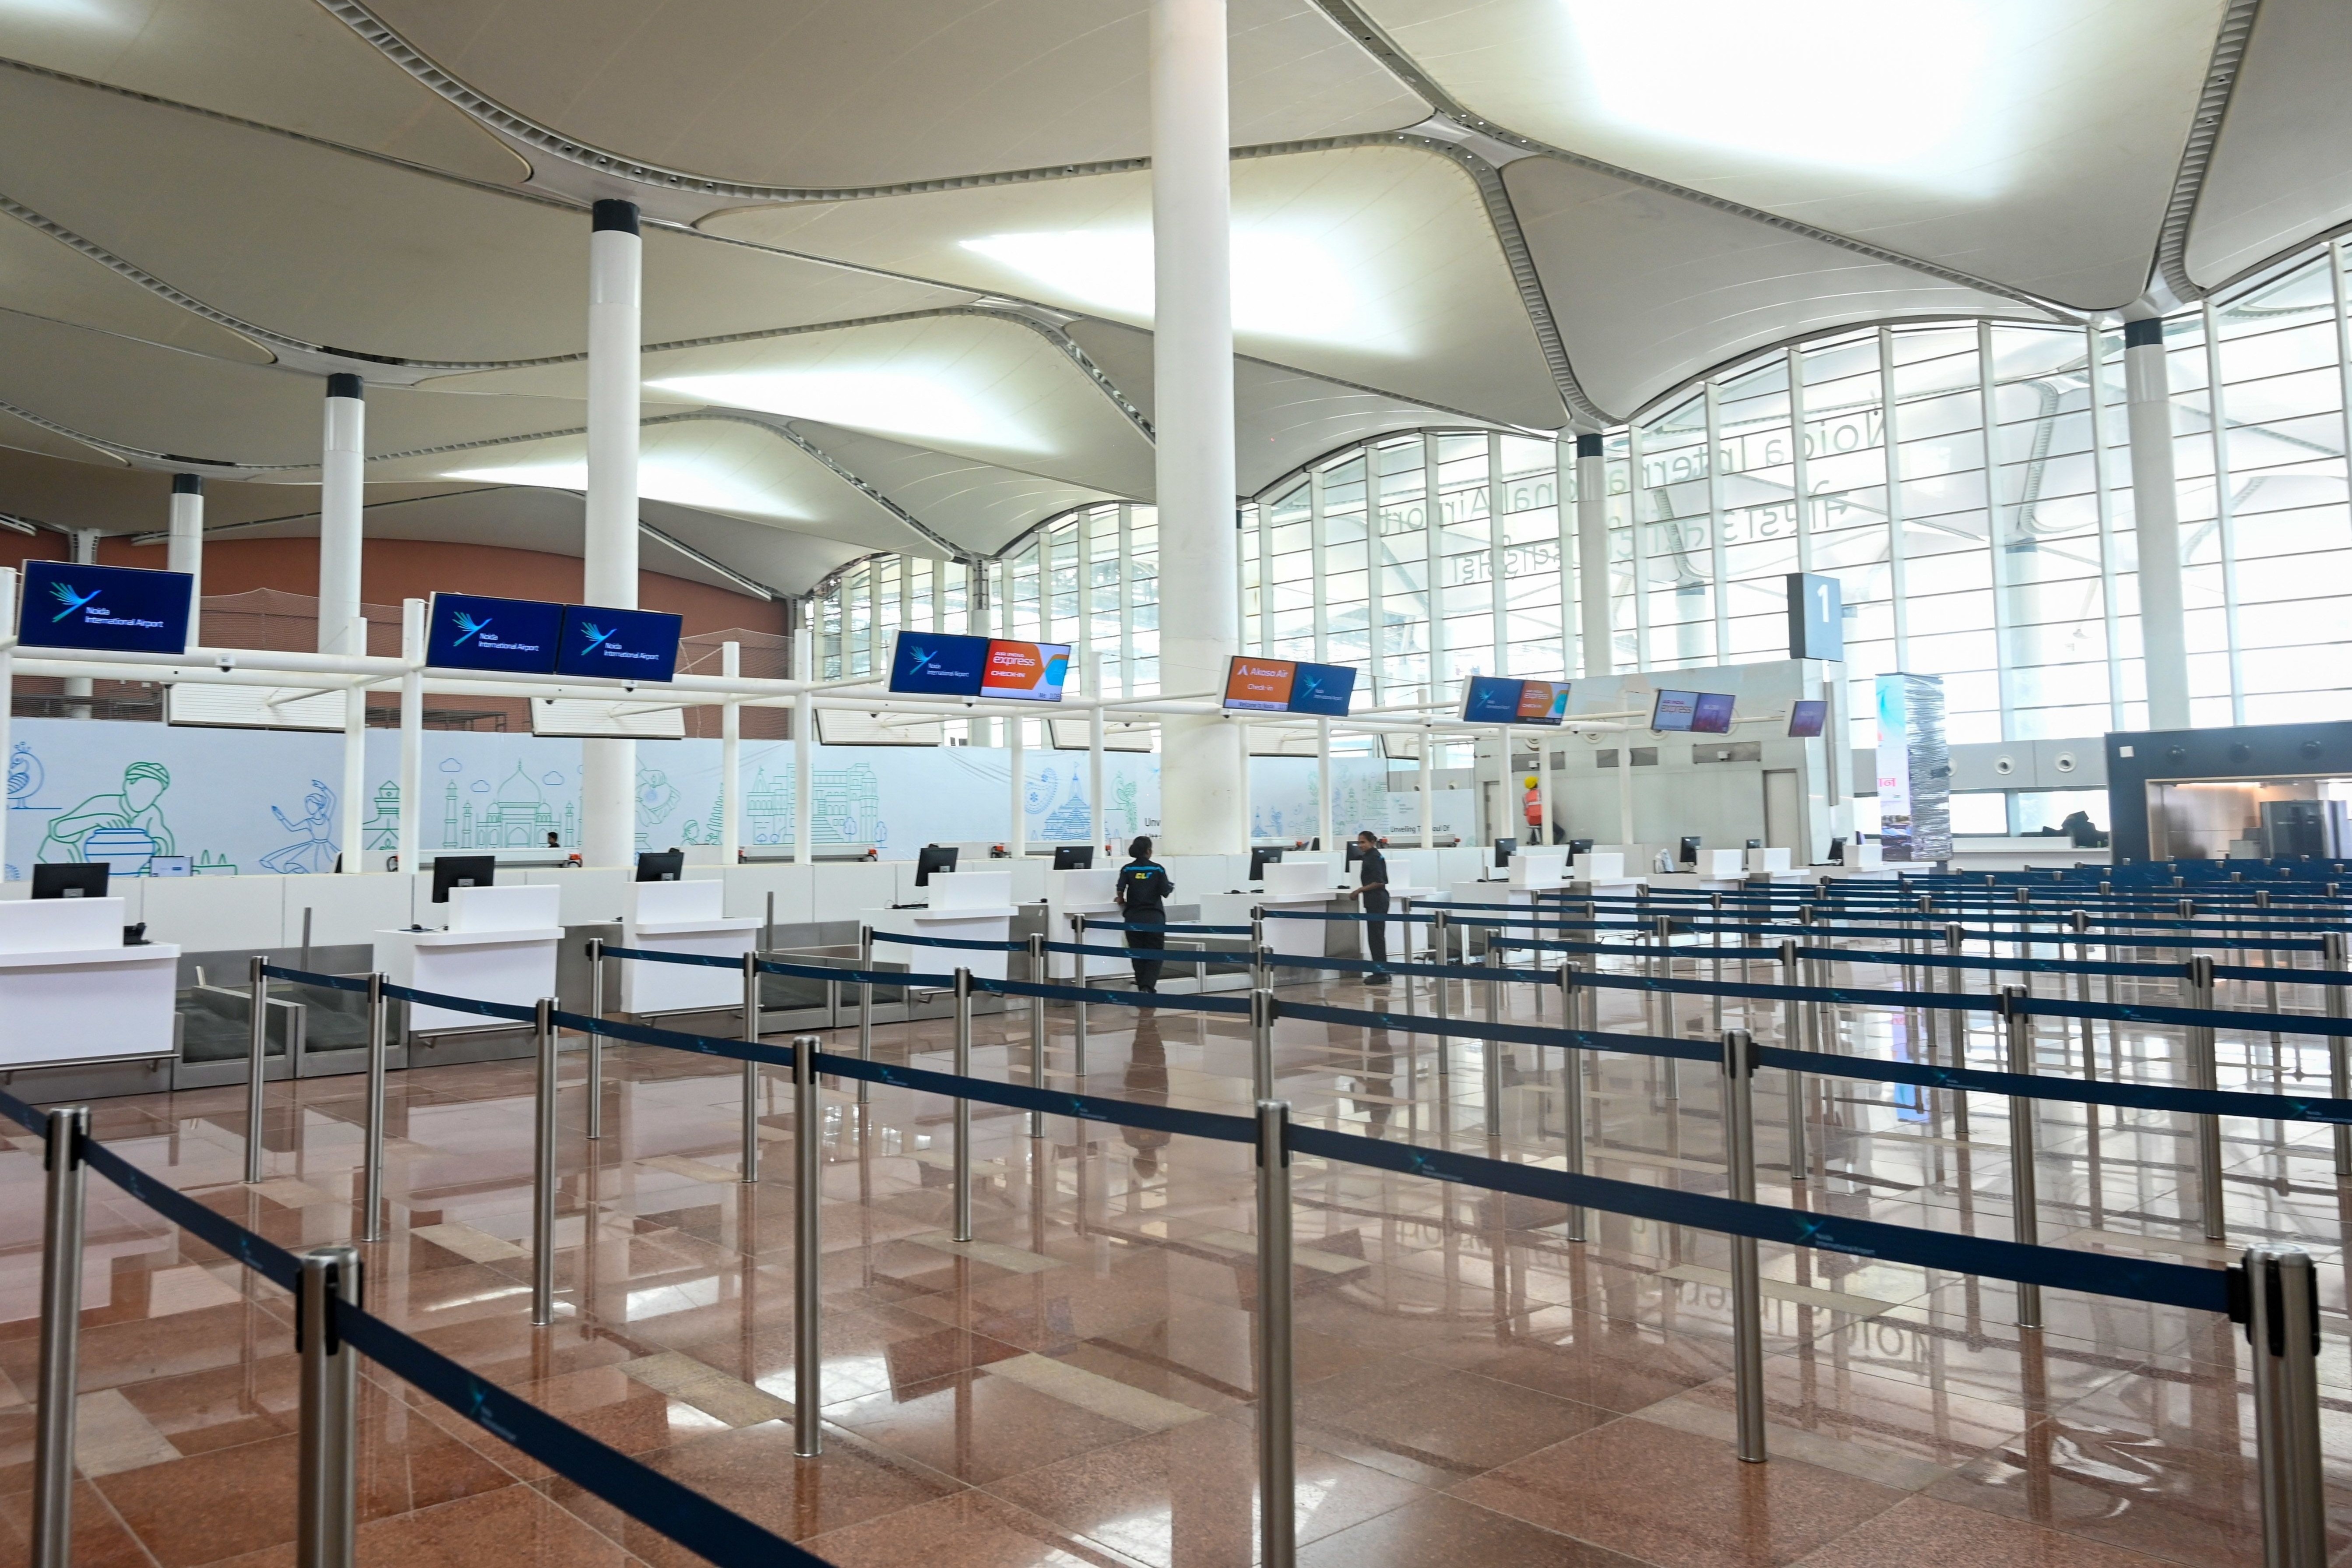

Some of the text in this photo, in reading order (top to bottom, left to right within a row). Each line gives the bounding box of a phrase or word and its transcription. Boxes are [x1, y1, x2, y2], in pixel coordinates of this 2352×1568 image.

[1817, 584, 1829, 623] 1
[86, 607, 110, 615] Noida
[85, 616, 164, 628] International Airport
[478, 641, 518, 649] International
[604, 650, 640, 658] International
[993, 656, 1035, 666] express
[1250, 668, 1289, 678] Akasa Air
